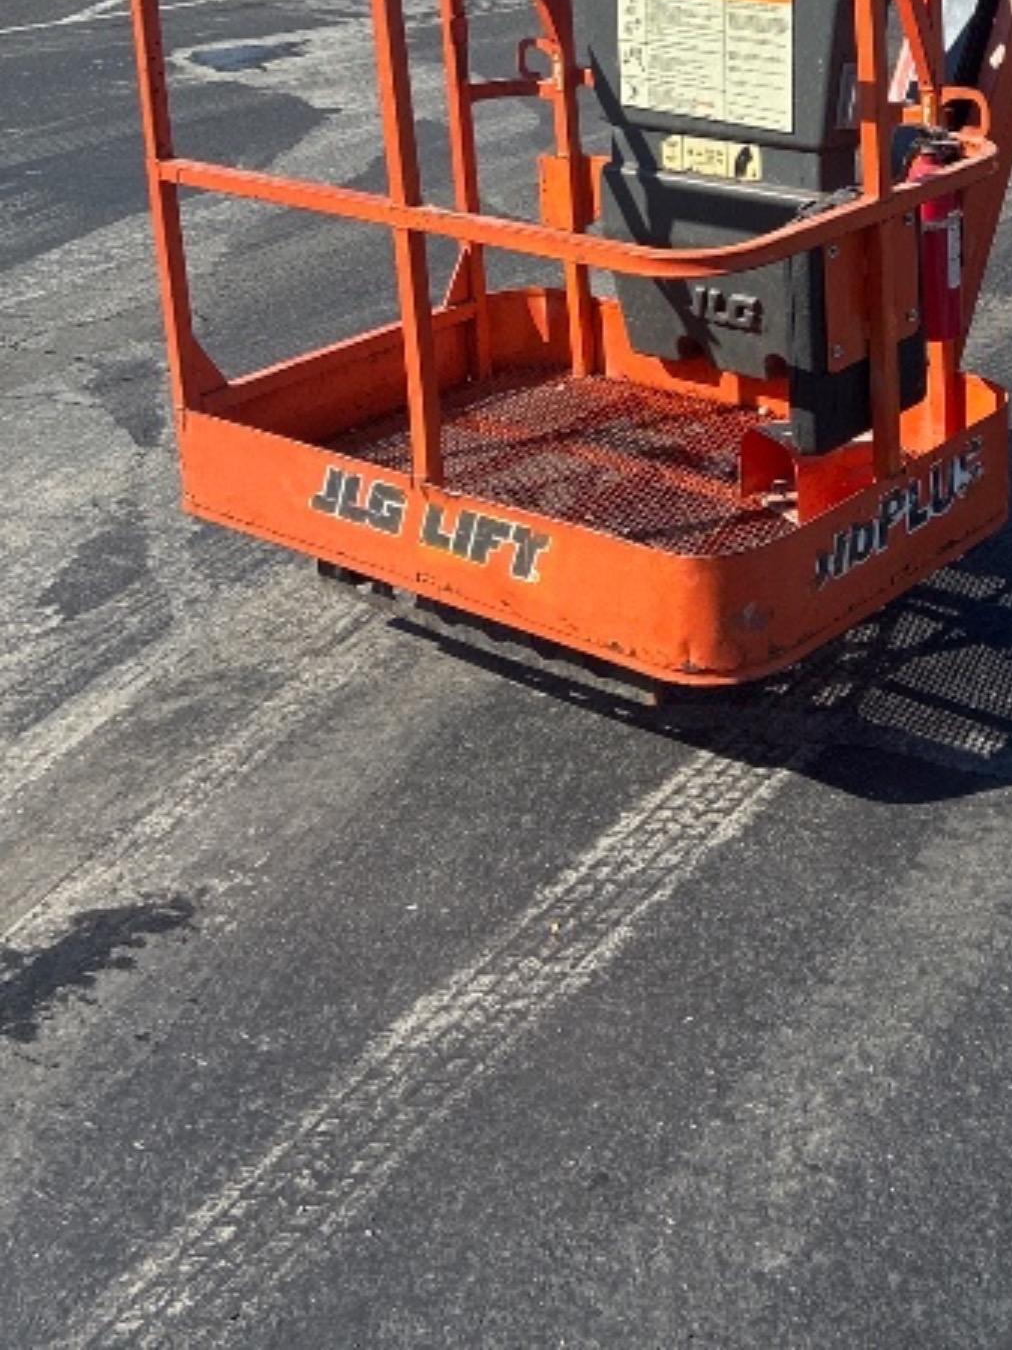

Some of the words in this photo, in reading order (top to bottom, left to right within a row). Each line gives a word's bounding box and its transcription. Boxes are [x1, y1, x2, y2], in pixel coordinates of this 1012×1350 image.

[688, 286, 763, 336] JLG
[309, 464, 408, 538] JLG
[419, 502, 552, 584] LIFT
